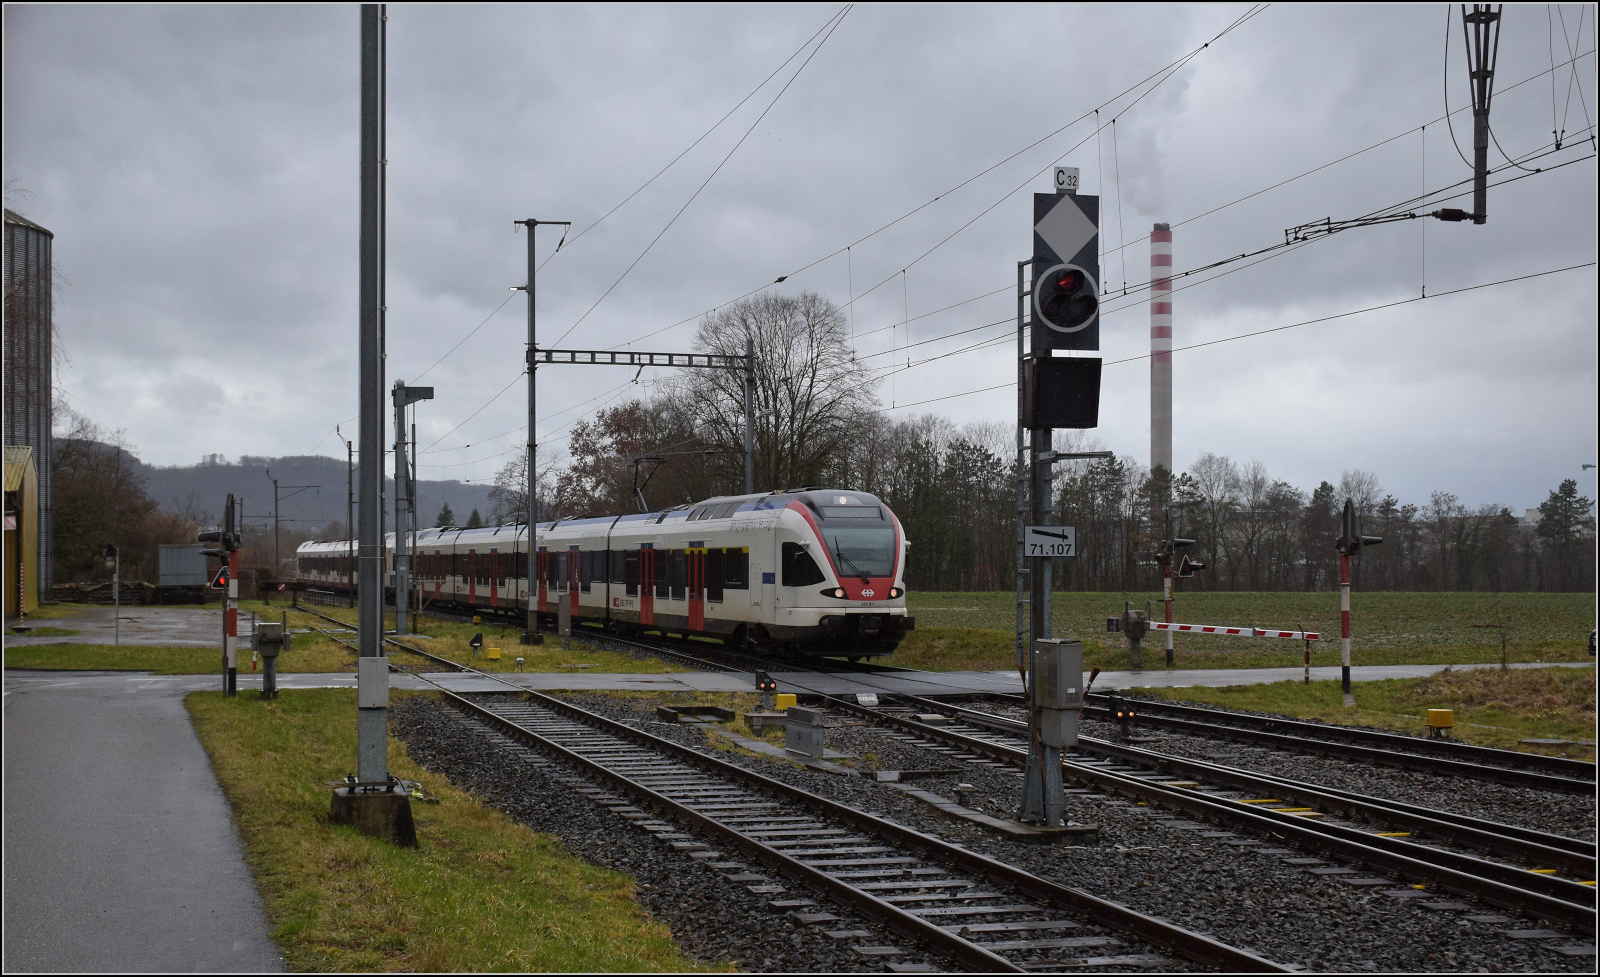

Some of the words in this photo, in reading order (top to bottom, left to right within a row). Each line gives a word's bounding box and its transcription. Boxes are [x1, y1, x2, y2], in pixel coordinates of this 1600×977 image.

[1056, 169, 1065, 186] C
[1067, 175, 1077, 186] 32
[1030, 543, 1072, 555] 71.107
